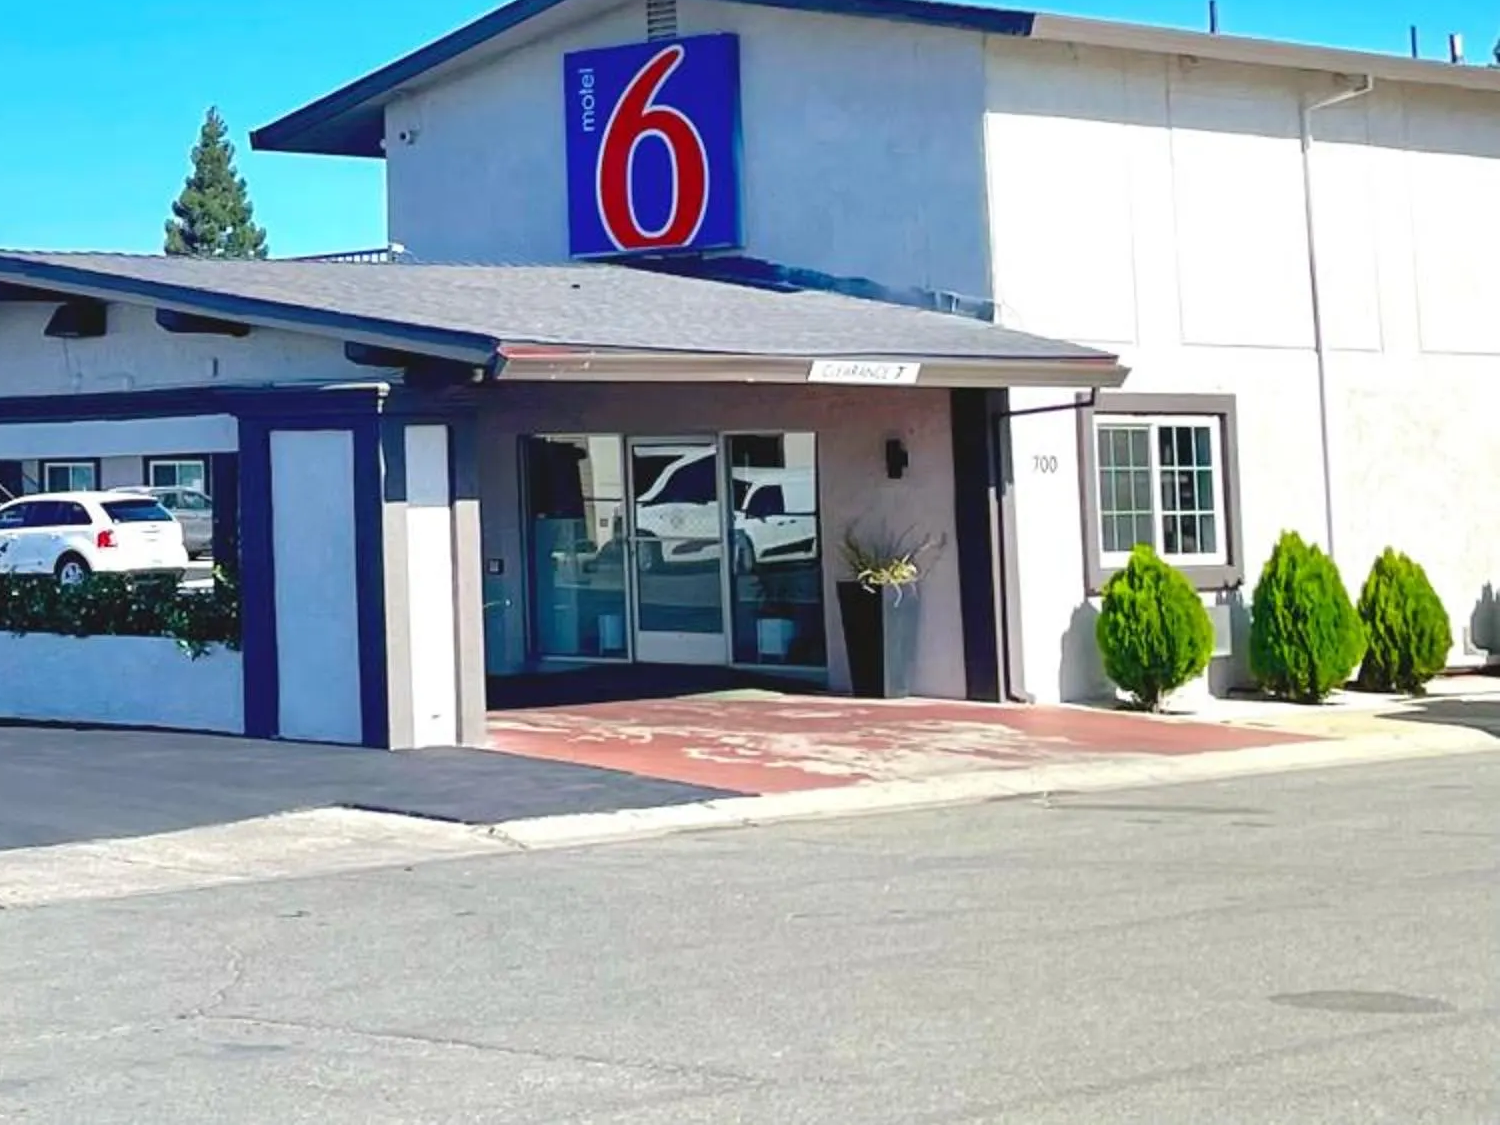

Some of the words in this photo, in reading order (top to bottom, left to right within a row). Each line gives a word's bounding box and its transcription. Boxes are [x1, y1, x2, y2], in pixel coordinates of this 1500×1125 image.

[578, 68, 595, 132] motel
[596, 44, 710, 251] 6
[1033, 455, 1058, 474] 700
